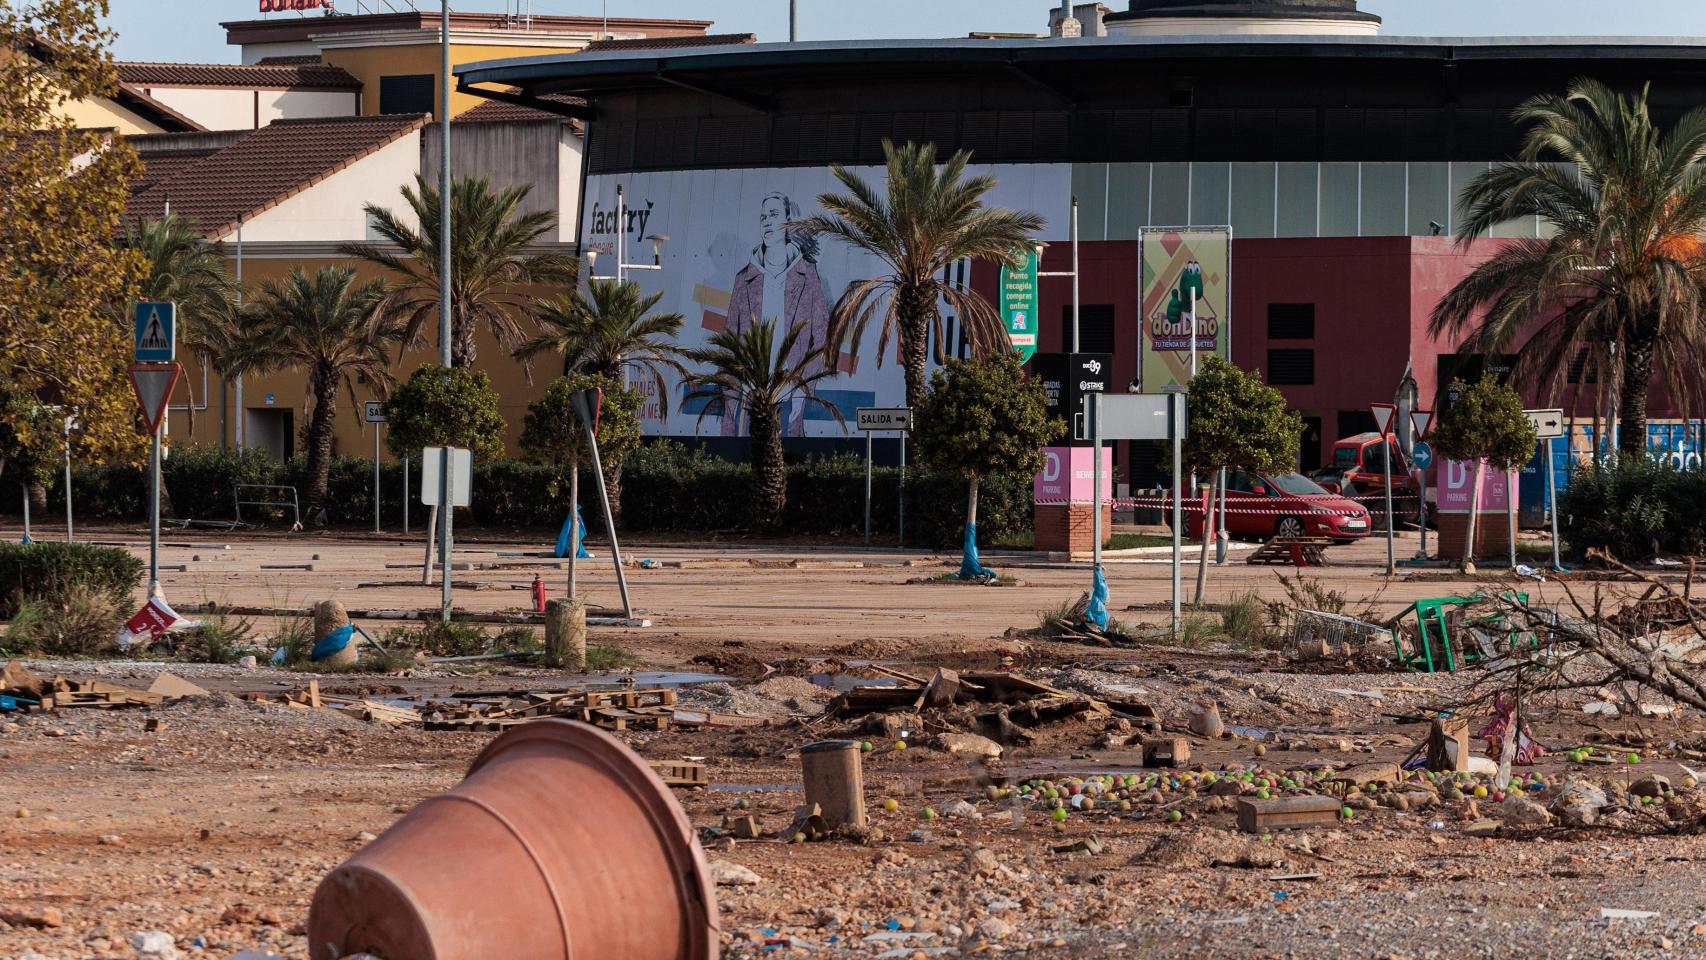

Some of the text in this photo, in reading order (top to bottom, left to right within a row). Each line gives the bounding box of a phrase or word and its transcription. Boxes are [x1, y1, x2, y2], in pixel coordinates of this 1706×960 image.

[590, 202, 651, 242] factry
[1009, 271, 1029, 280] Punto
[1006, 282, 1032, 291] recogida
[1006, 292, 1032, 301] compras
[1009, 302, 1029, 310] online
[861, 414, 892, 424] SALIDA
[1043, 451, 1060, 482] D
[1447, 457, 1467, 489] D
